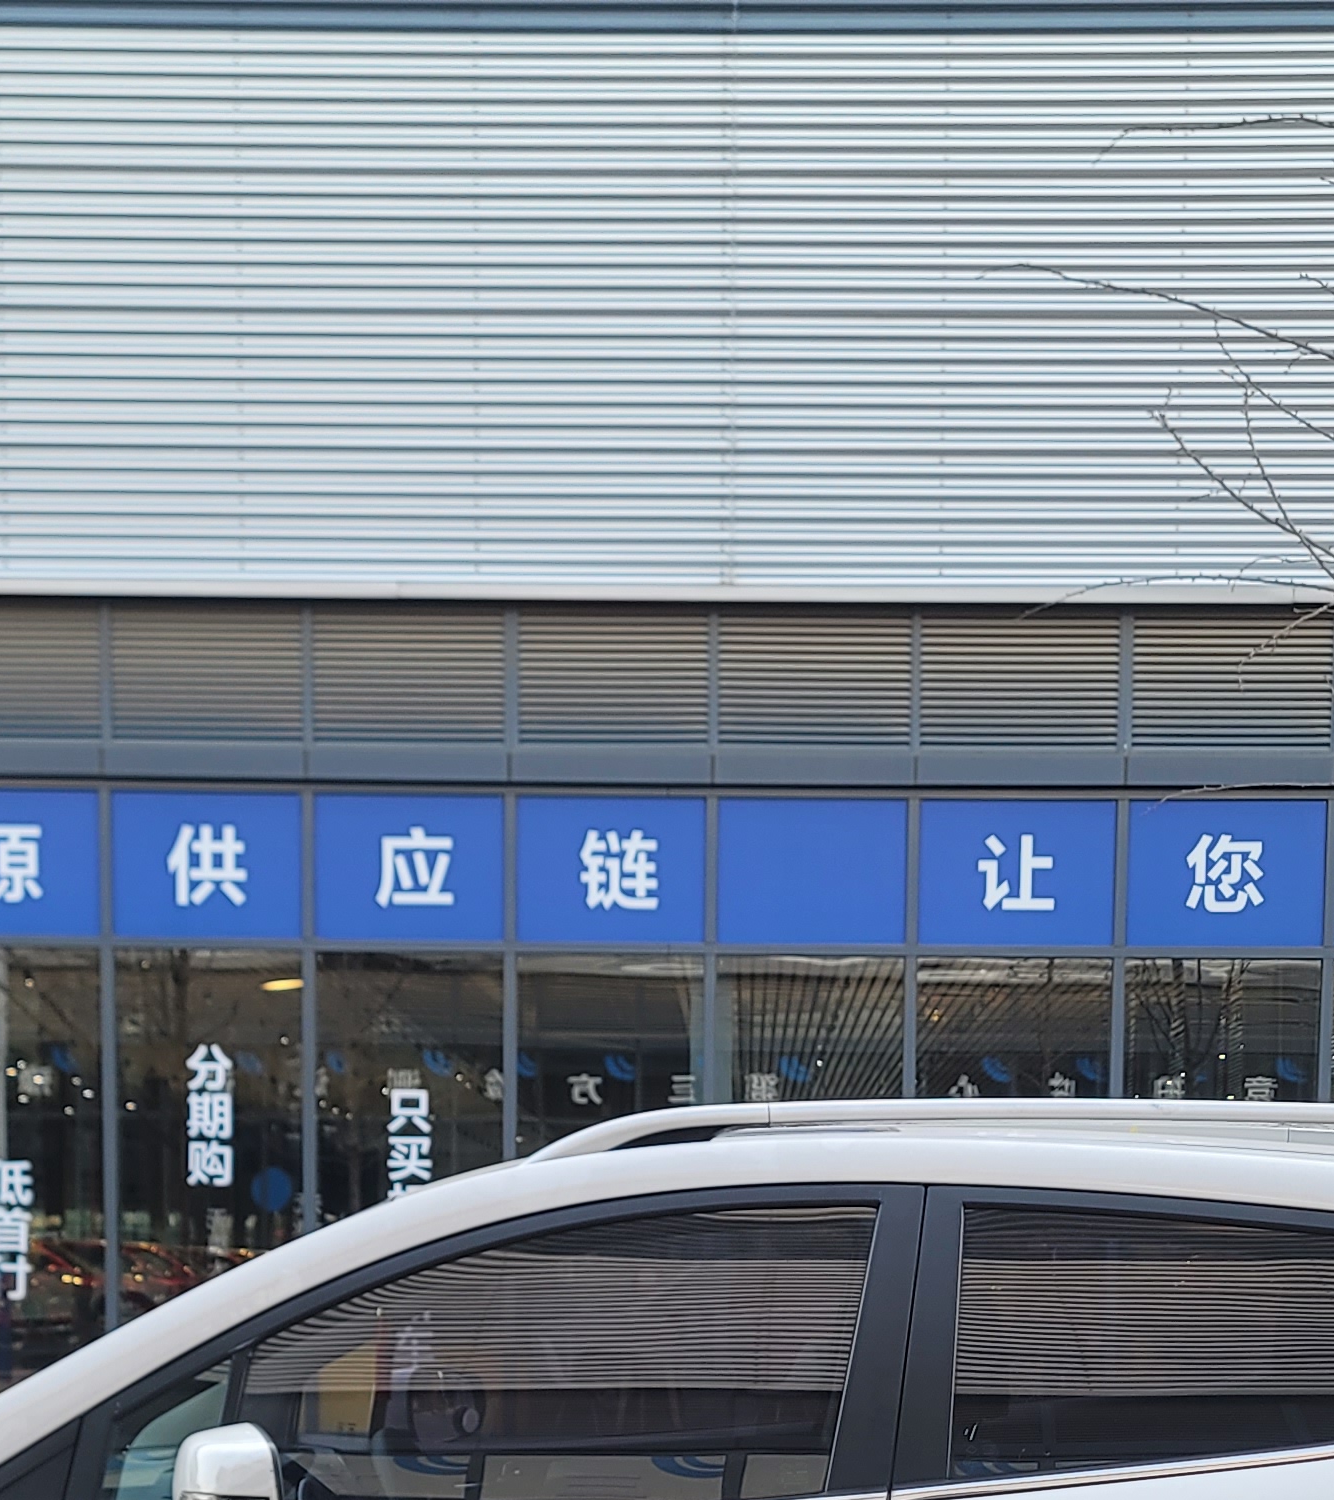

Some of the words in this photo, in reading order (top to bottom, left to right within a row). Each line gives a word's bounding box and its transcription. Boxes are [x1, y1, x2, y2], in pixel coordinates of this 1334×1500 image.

[185, 1043, 233, 1187] 分期购
[386, 1088, 433, 1200] 只买
